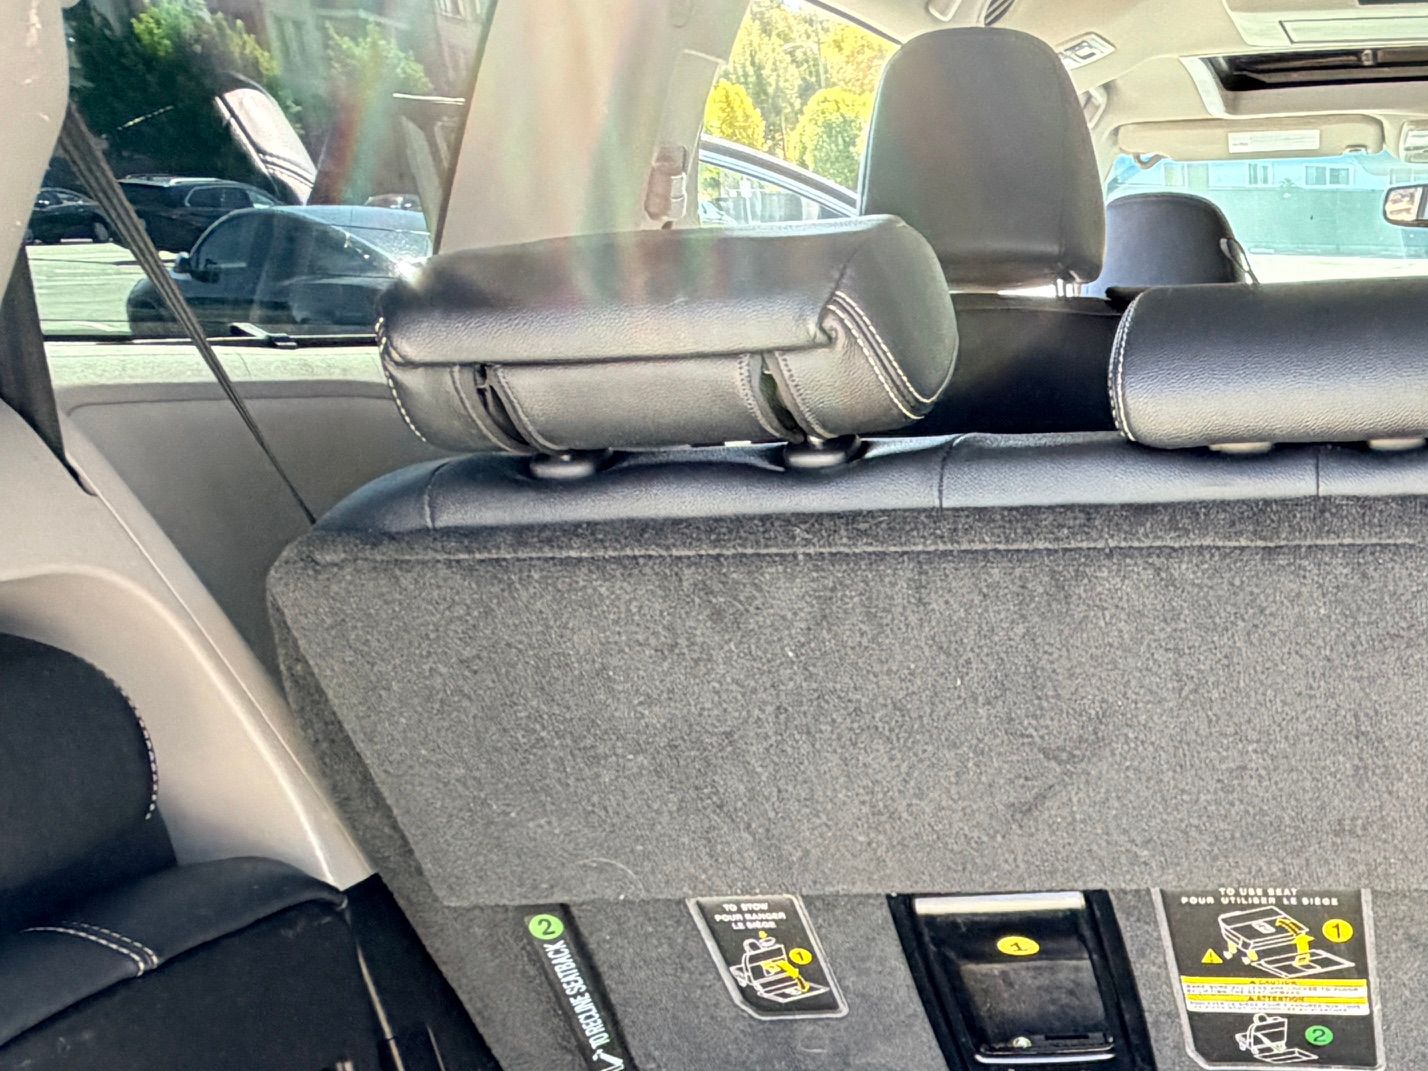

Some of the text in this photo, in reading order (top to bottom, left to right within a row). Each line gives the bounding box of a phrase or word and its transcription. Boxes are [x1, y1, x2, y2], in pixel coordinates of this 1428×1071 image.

[1219, 887, 1298, 896] TO USE SEAT
[1181, 896, 1215, 905] POUR
[1221, 896, 1276, 905] UTILISER
[1283, 896, 1297, 905] LE
[723, 903, 737, 911] TO
[537, 918, 555, 935] 2
[731, 921, 746, 930] LE
[543, 940, 610, 1049] TO RECLINE SEATBACK
